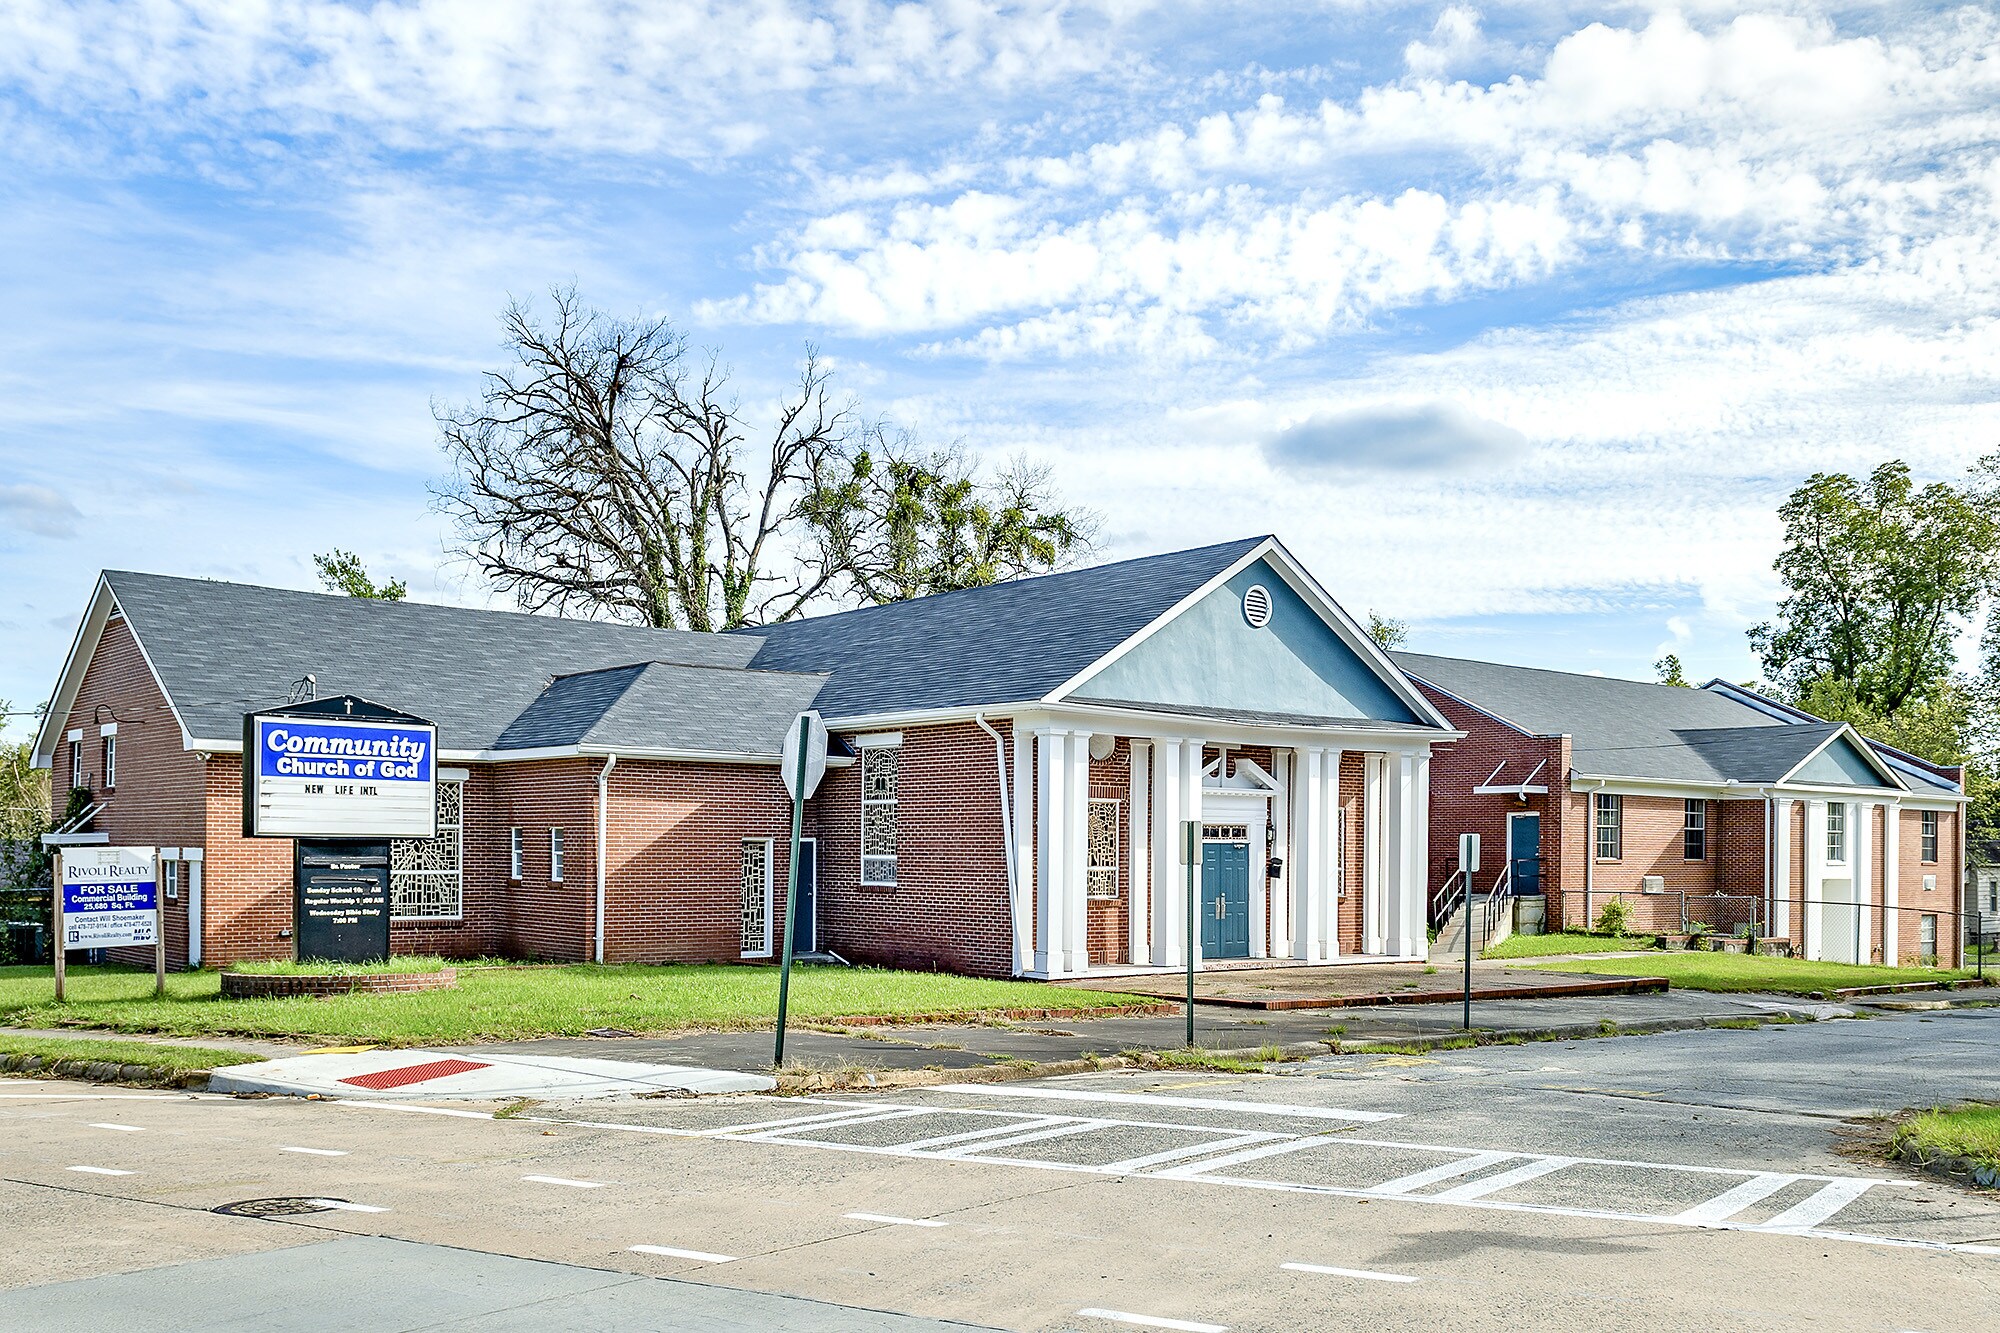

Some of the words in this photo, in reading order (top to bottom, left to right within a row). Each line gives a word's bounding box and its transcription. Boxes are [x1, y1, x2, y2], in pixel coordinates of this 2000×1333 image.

[267, 729, 426, 763] Community
[276, 757, 350, 776] Church
[354, 760, 375, 777] of
[380, 761, 419, 778] God
[305, 785, 324, 794] NEW
[335, 785, 353, 795] LIFE
[360, 786, 378, 796] INTL
[81, 885, 105, 895] FOR
[108, 884, 138, 894] SALE
[306, 887, 330, 895] Sunday
[71, 894, 115, 903] Commercial
[117, 893, 147, 902] Building
[304, 898, 329, 906] Regular
[309, 909, 345, 917] Wednesday
[362, 908, 380, 916] Study
[112, 914, 145, 922] Shoemaker
